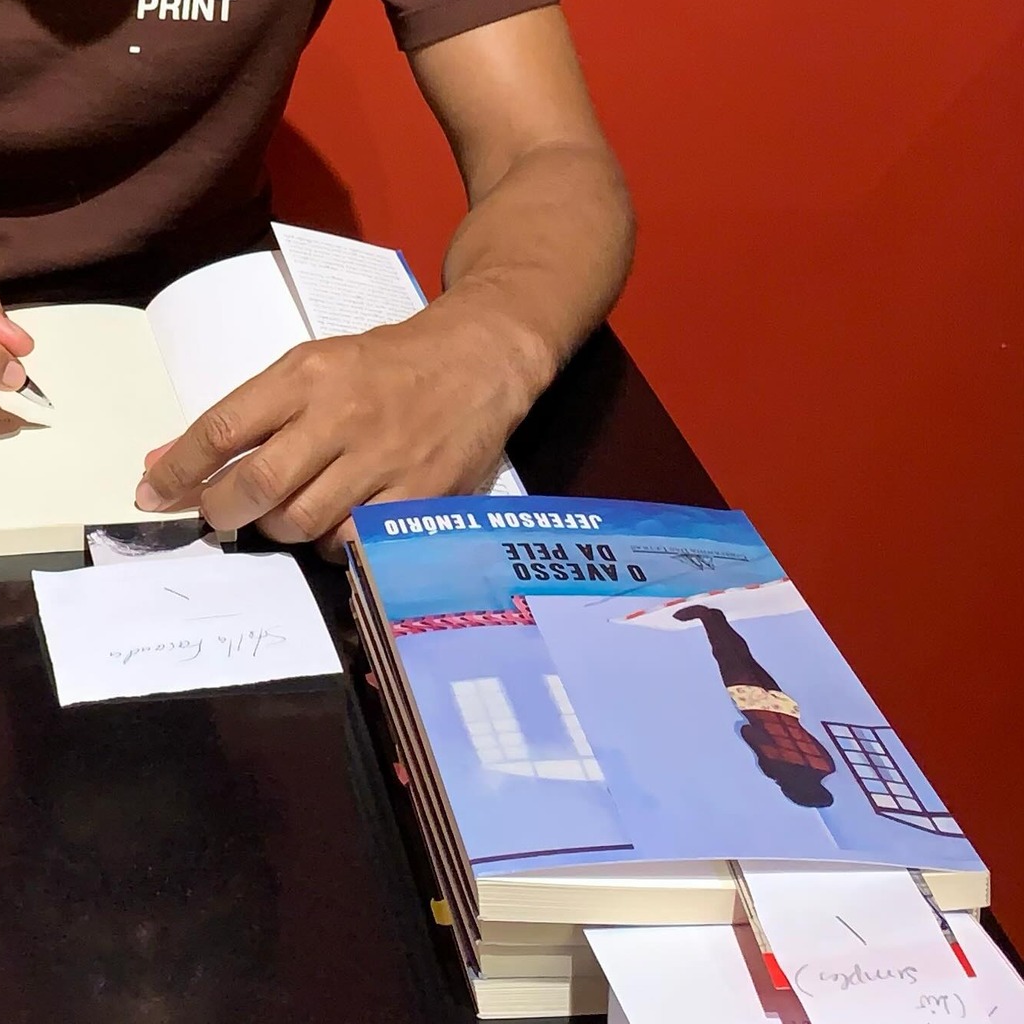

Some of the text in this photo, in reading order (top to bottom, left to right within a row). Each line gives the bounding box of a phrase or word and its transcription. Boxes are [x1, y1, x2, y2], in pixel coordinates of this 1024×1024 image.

[383, 512, 603, 536] JEFERSON TENÓRIO
[502, 543, 569, 562] PELE
[576, 543, 618, 562] DA
[512, 563, 648, 582] O AVESSO
